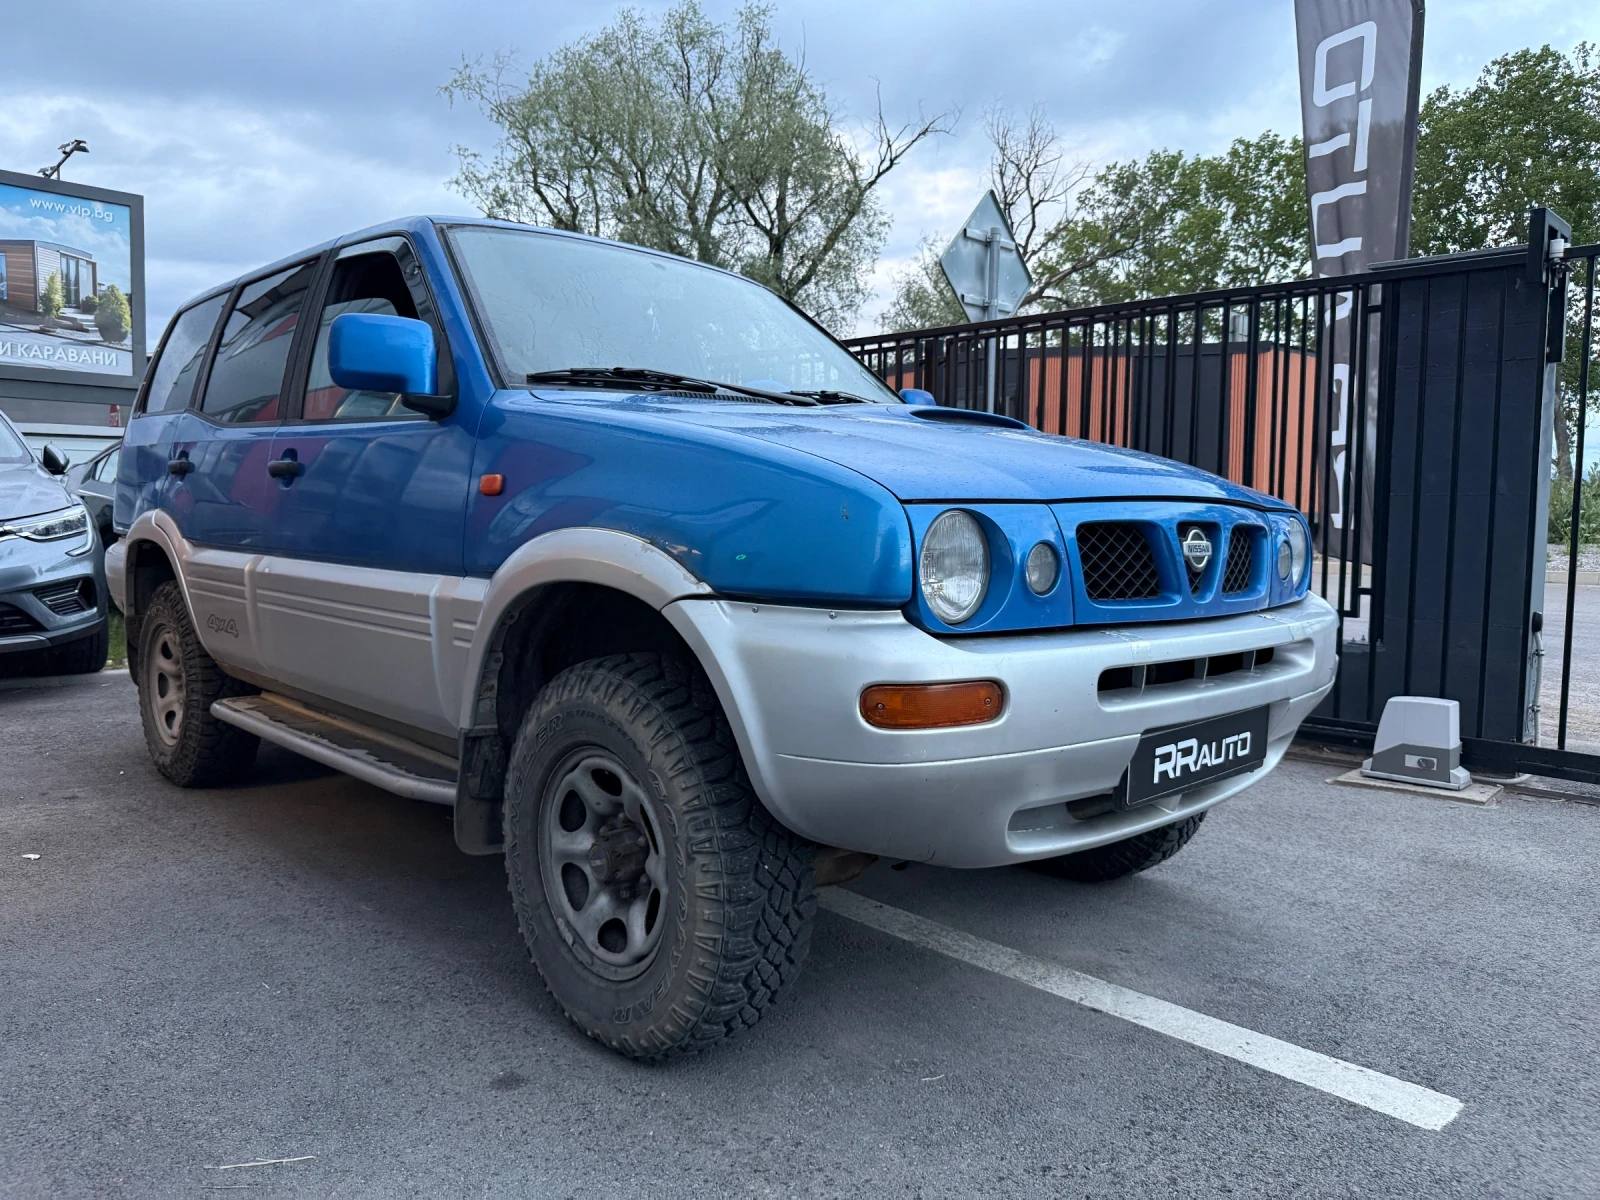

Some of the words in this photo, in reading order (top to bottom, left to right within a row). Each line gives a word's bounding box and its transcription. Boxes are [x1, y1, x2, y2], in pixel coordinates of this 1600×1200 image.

[30, 199, 113, 222] www.vlp.bg
[18, 343, 117, 366] КАРАВАНИ
[1187, 543, 1210, 554] NISSAN
